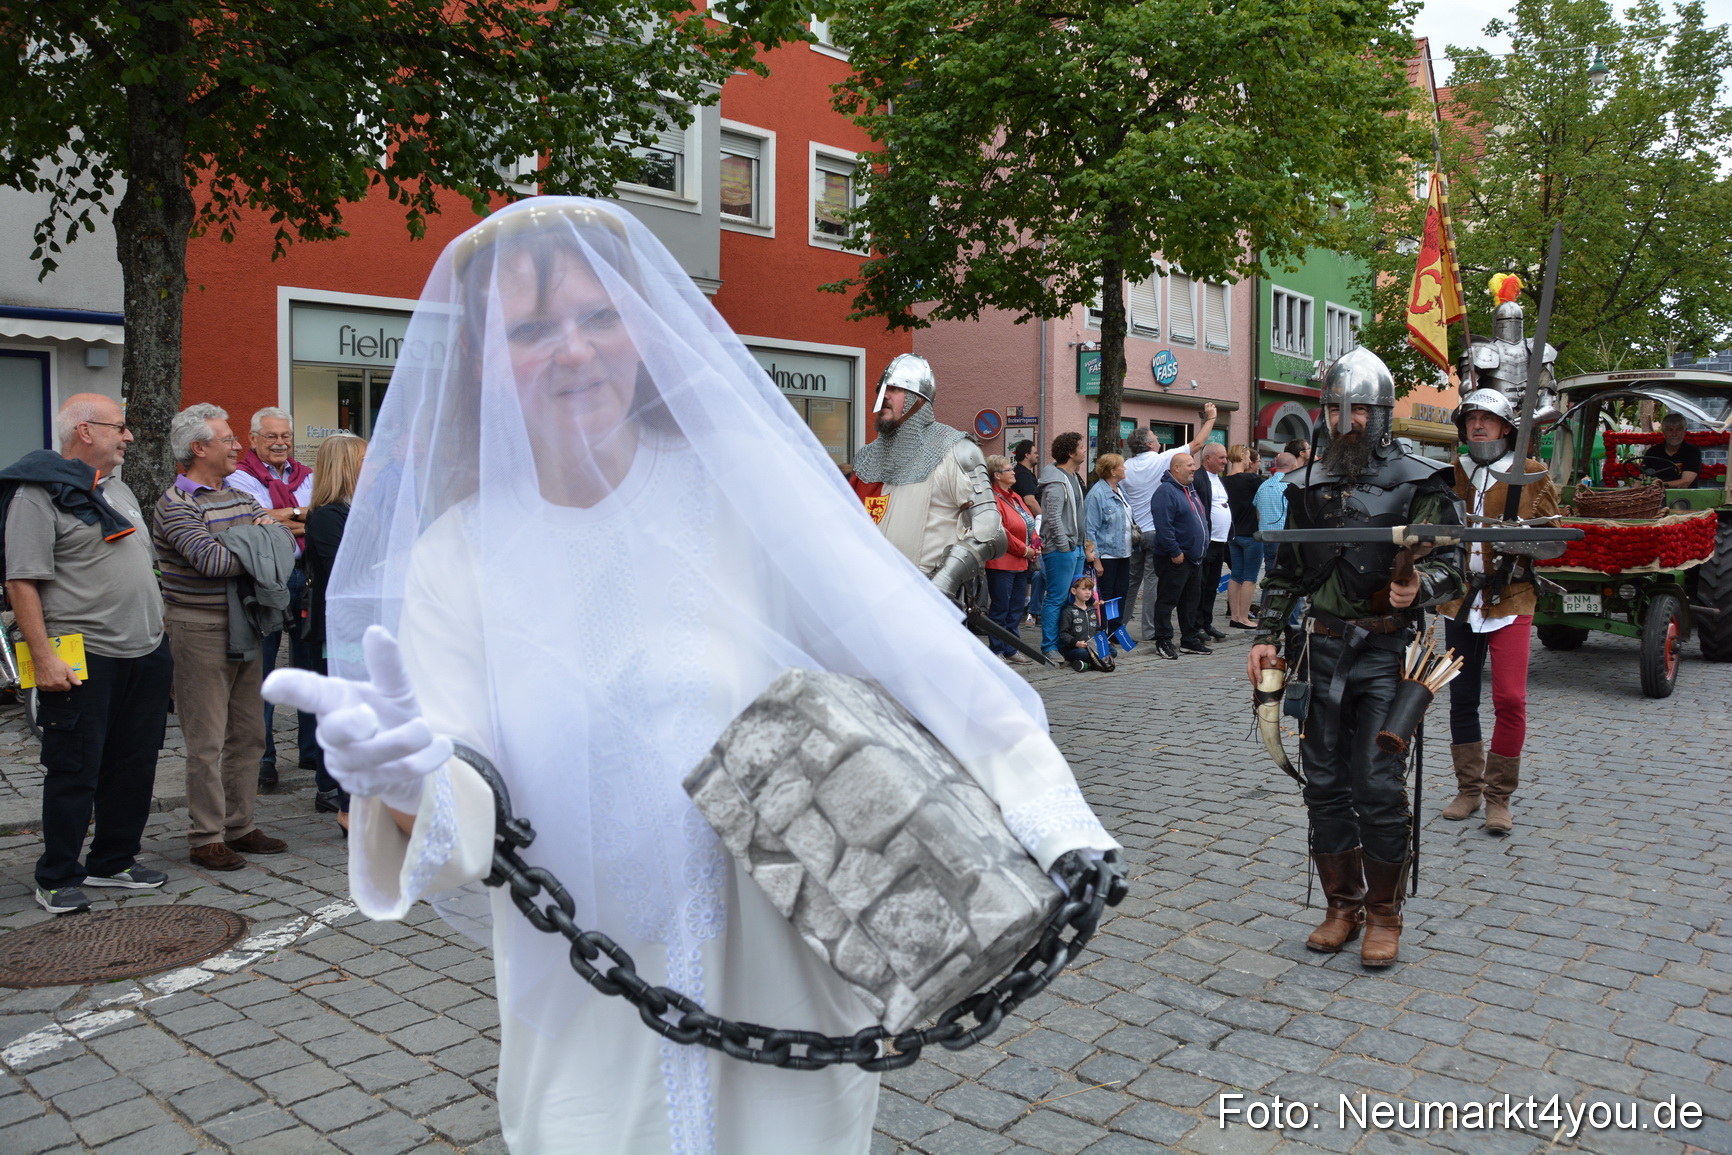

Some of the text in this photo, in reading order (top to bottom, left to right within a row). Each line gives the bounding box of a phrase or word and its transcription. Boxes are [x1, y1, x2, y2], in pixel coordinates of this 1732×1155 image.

[1152, 354, 1167, 367] vom
[764, 363, 826, 391] lmann
[1157, 361, 1178, 382] FASS
[1573, 595, 1591, 604] NM
[1566, 603, 1599, 612] RP 83
